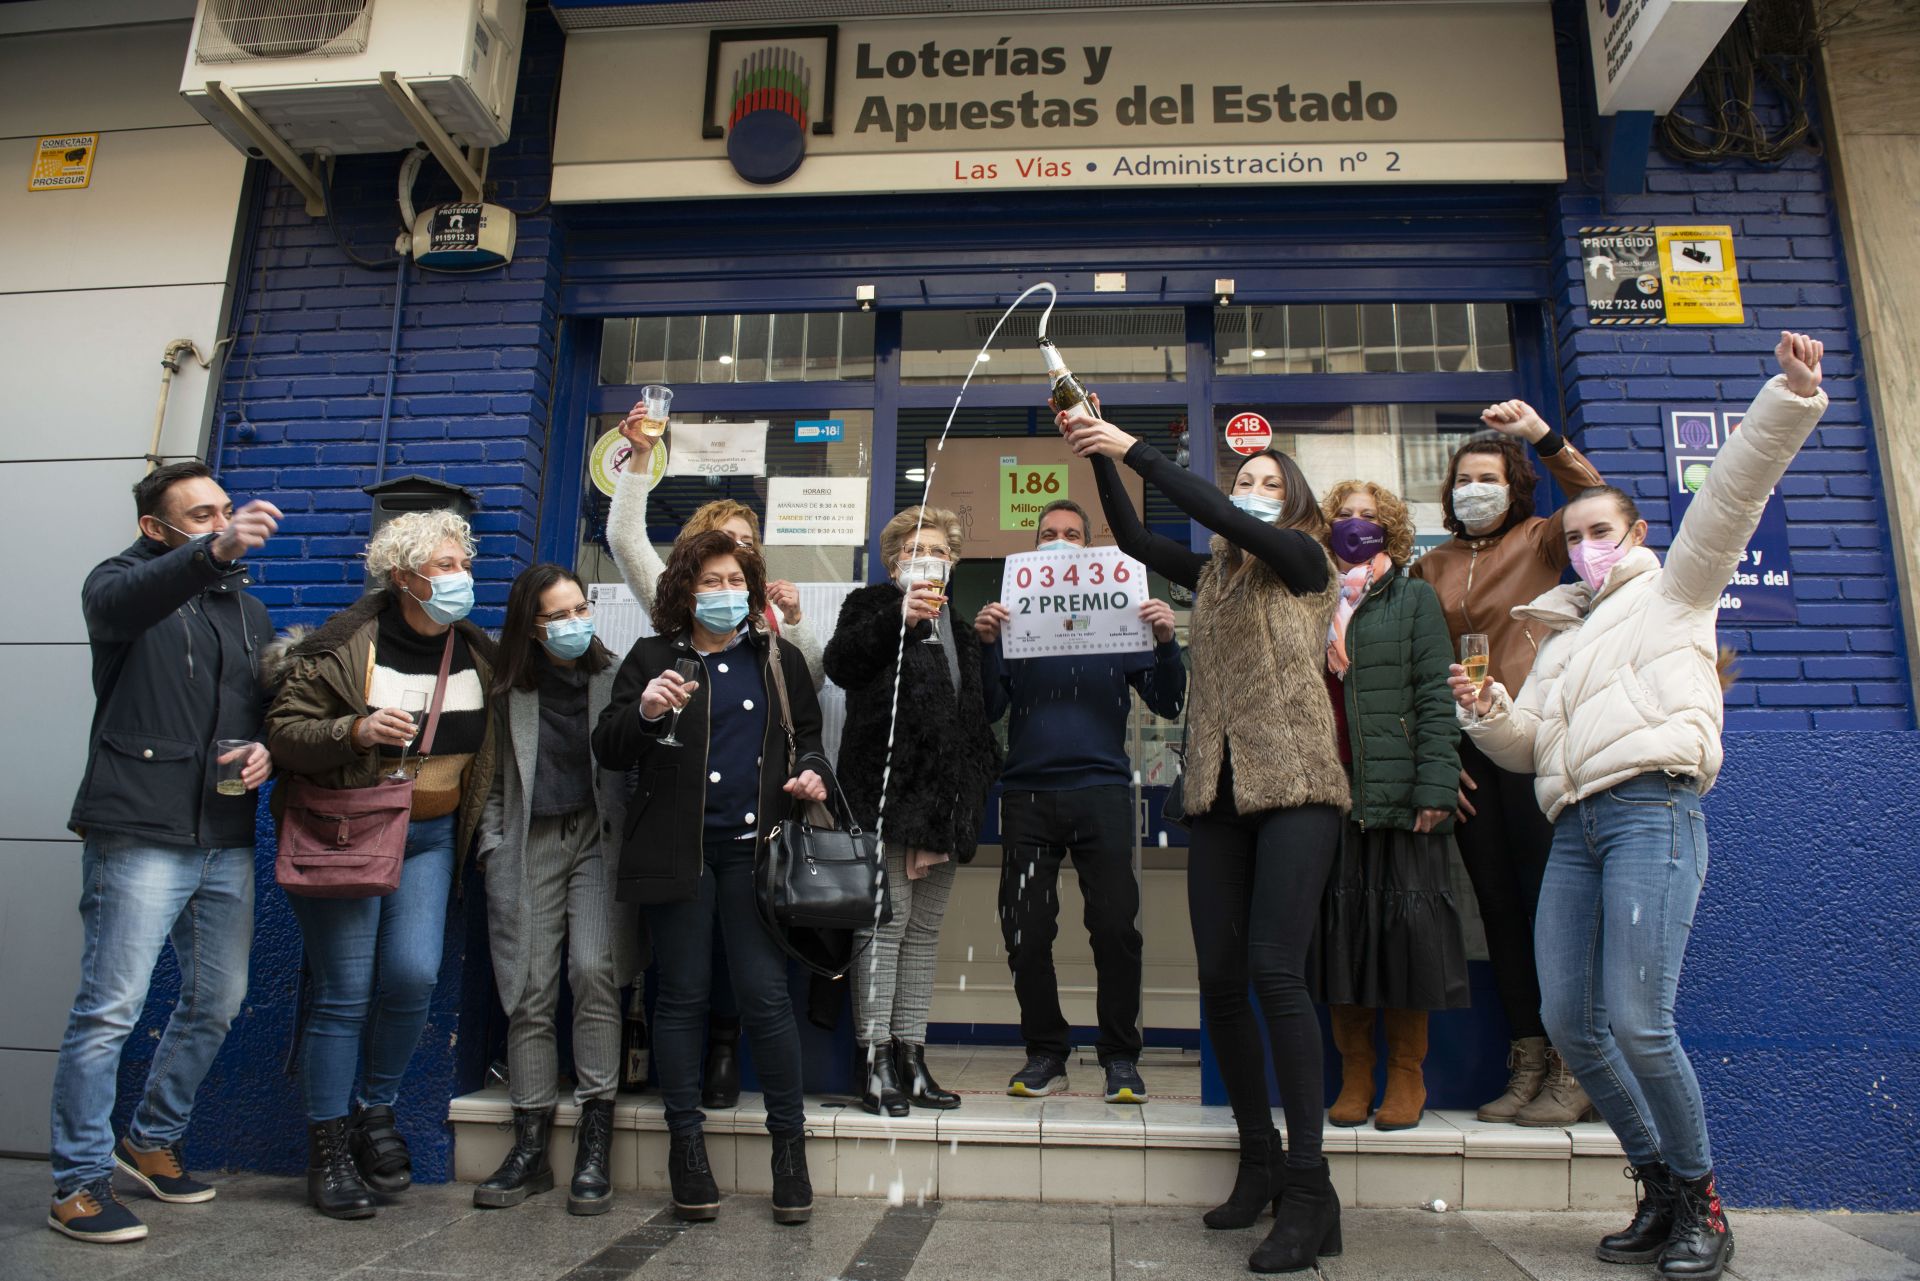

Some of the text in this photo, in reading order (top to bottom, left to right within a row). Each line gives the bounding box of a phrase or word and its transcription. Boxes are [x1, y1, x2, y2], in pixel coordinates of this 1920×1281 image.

[856, 37, 1113, 85] Loterías y
[1608, 41, 1633, 84] Estado
[853, 80, 1398, 142] Apuestas del Estado
[42, 137, 93, 147] CONECTADA
[954, 160, 998, 180] Las
[1015, 157, 1072, 178] Vías
[1113, 152, 1323, 176] Administración
[1385, 152, 1401, 172] 2
[33, 175, 85, 186] PROSEGUR
[1583, 237, 1654, 248] PROTEGIDO
[1590, 299, 1613, 310] 902
[1615, 299, 1638, 310] 732
[1640, 299, 1662, 309] 600
[820, 426, 837, 436] +18
[1234, 417, 1261, 431] +18
[1008, 471, 1060, 494] 1.86
[1011, 503, 1045, 513] Millon
[1020, 517, 1035, 527] de
[1751, 550, 1763, 566] y
[1016, 561, 1130, 589] 03436
[1763, 570, 1789, 586] del
[1039, 591, 1129, 613] PREMIO
